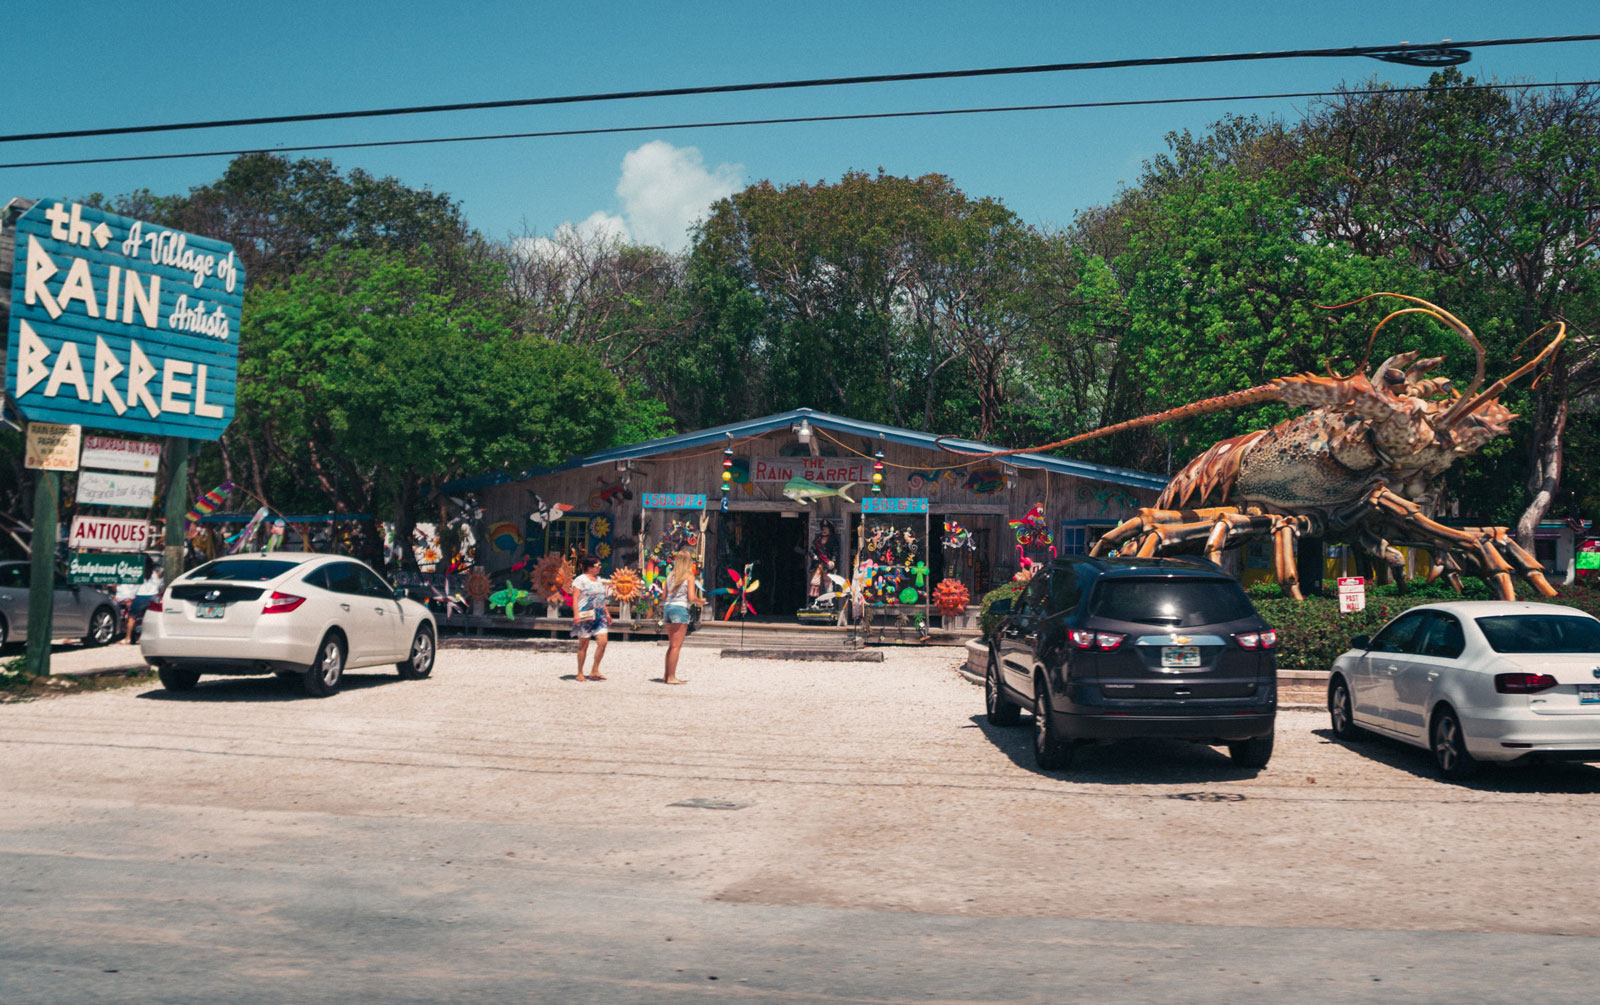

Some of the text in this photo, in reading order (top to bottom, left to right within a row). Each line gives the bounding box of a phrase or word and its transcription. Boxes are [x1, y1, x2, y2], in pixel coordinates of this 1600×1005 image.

[45, 202, 113, 249] the
[122, 221, 237, 293] A Village of
[24, 233, 161, 328] RAIN
[169, 294, 229, 340] Artists
[15, 318, 224, 419] BARREL
[756, 461, 869, 482] RAIN BARREL
[802, 458, 825, 469] THE
[651, 494, 697, 507] 50% OFF
[872, 498, 919, 511] 50% OFF
[75, 521, 146, 543] ANTIQUES
